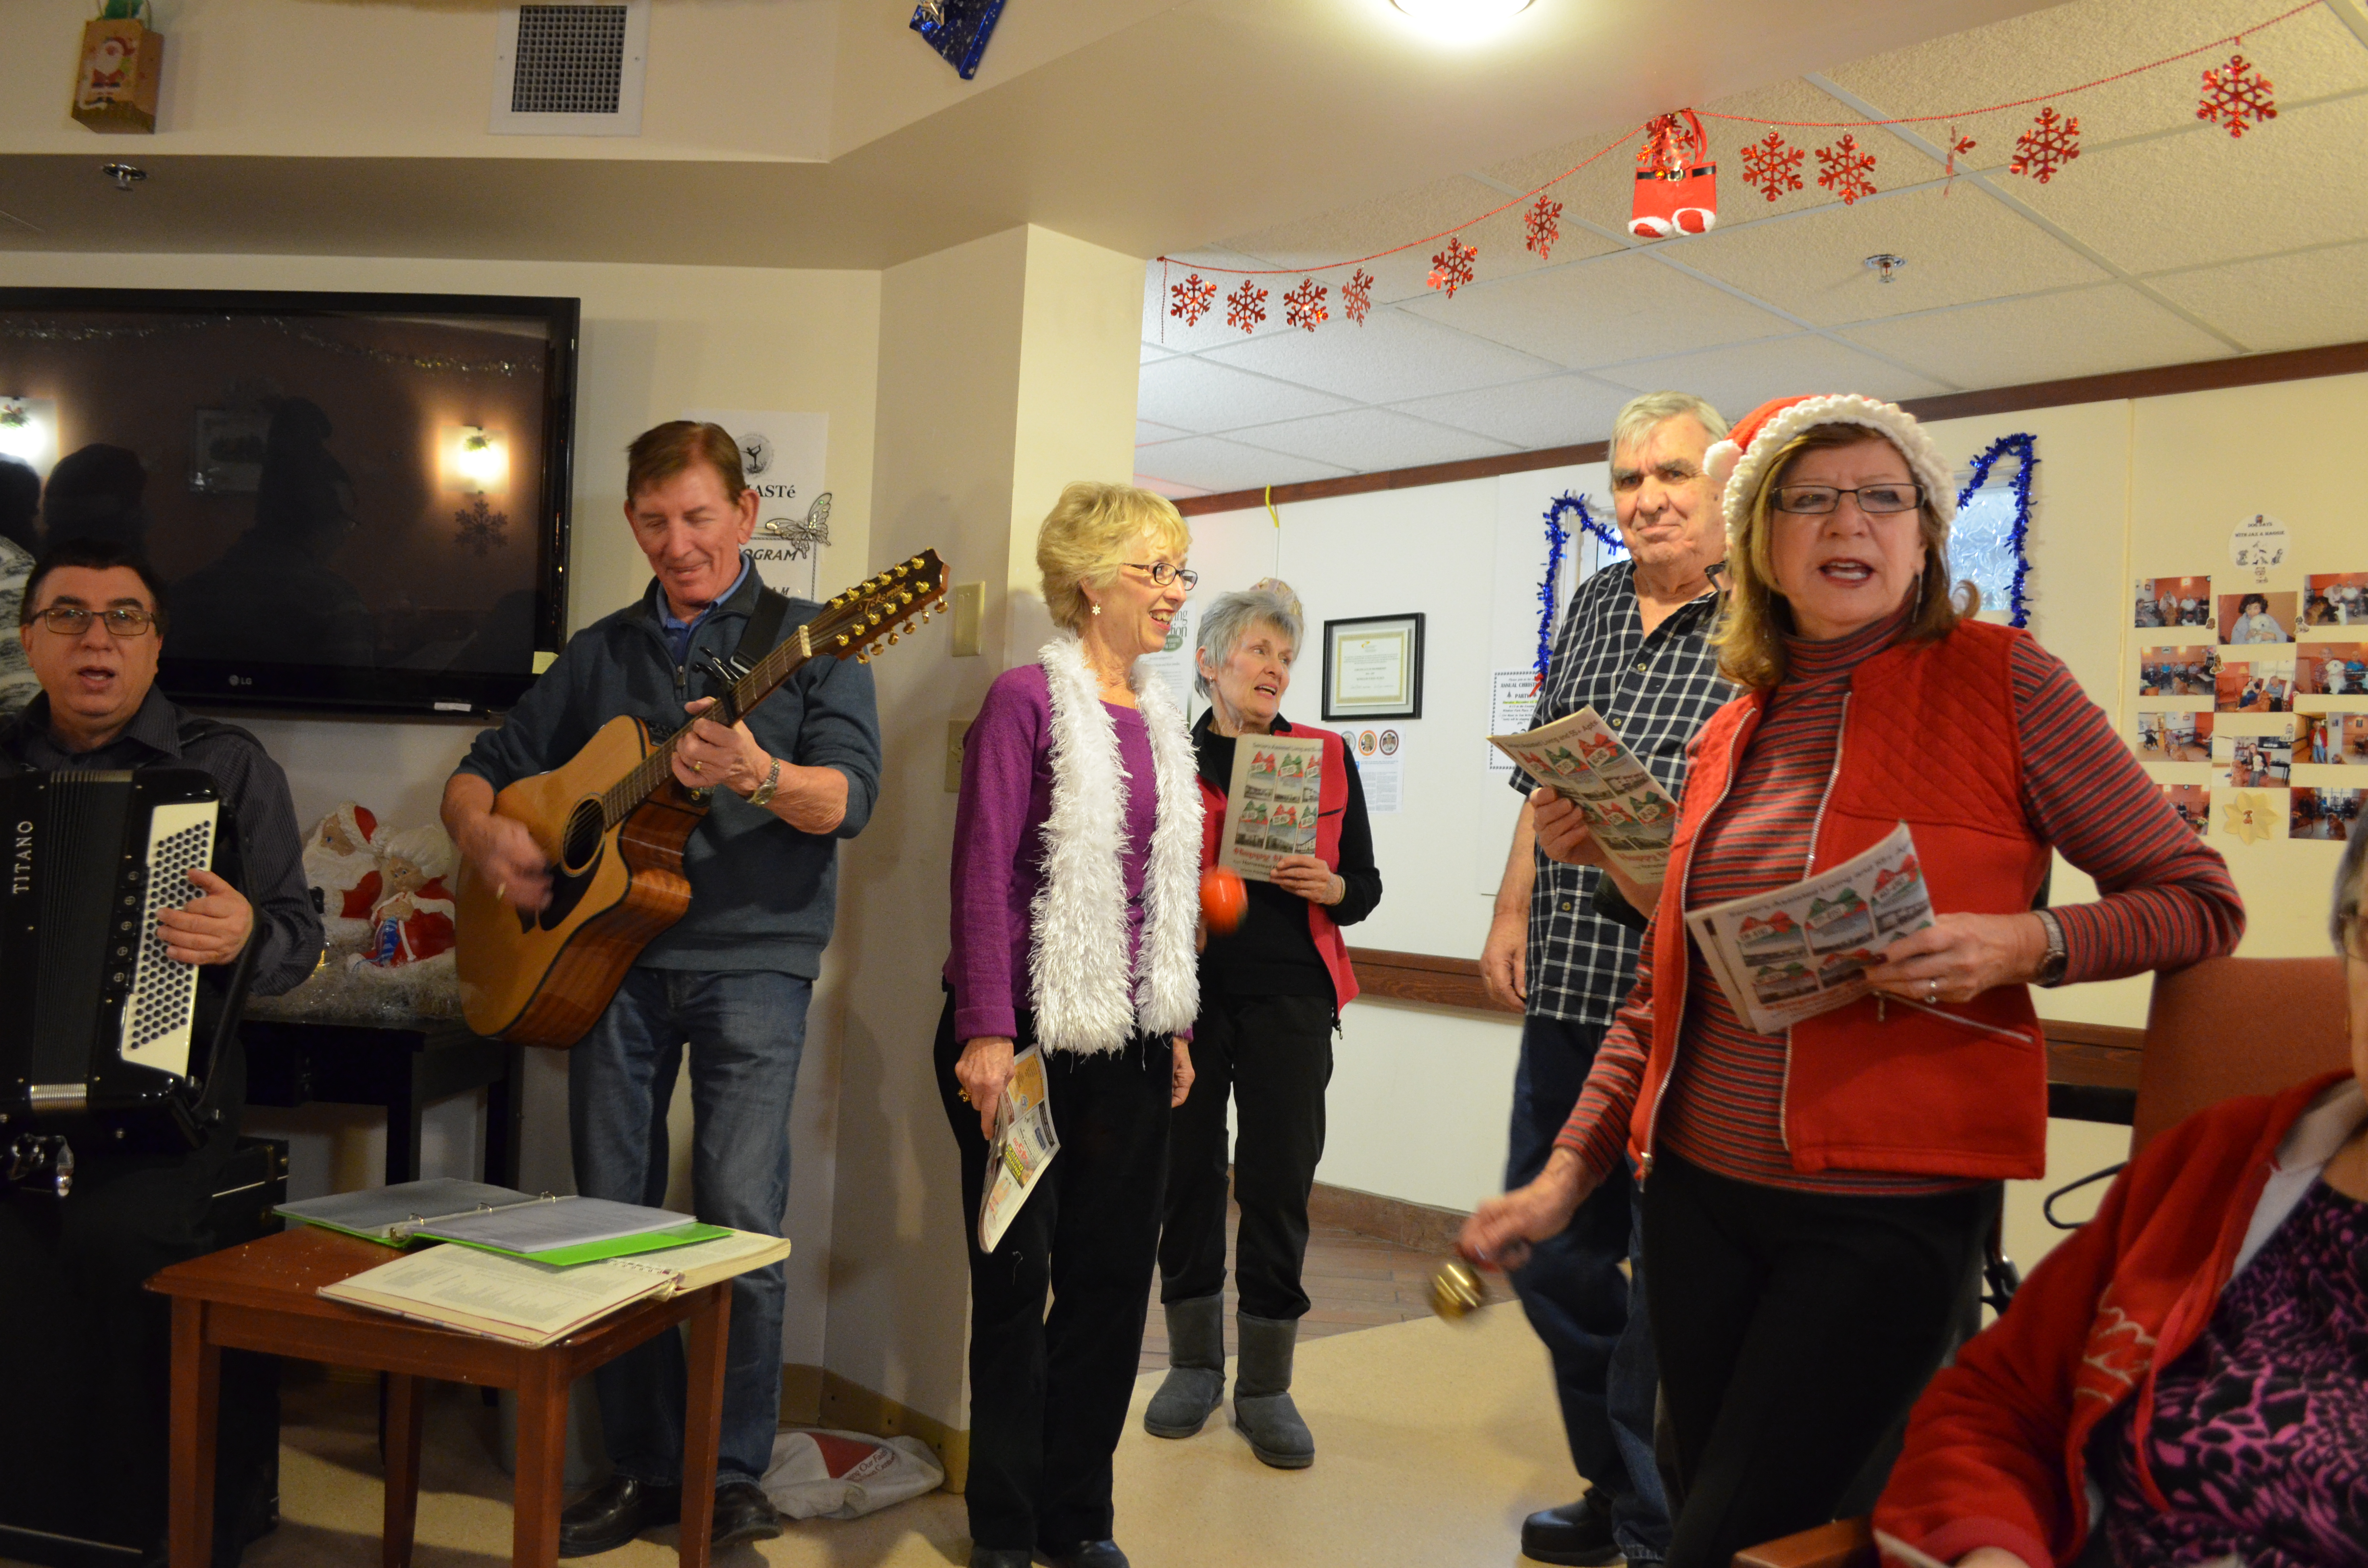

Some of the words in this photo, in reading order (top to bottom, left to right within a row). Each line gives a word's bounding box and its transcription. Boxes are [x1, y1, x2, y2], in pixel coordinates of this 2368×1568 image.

[746, 484, 796, 498] ASTé
[739, 549, 798, 561] OGRAM
[12, 821, 33, 894] TITANO
[1005, 1151, 1021, 1176] Dinner
[1008, 1145, 1024, 1171] Dance
[859, 1460, 873, 1471] Our
